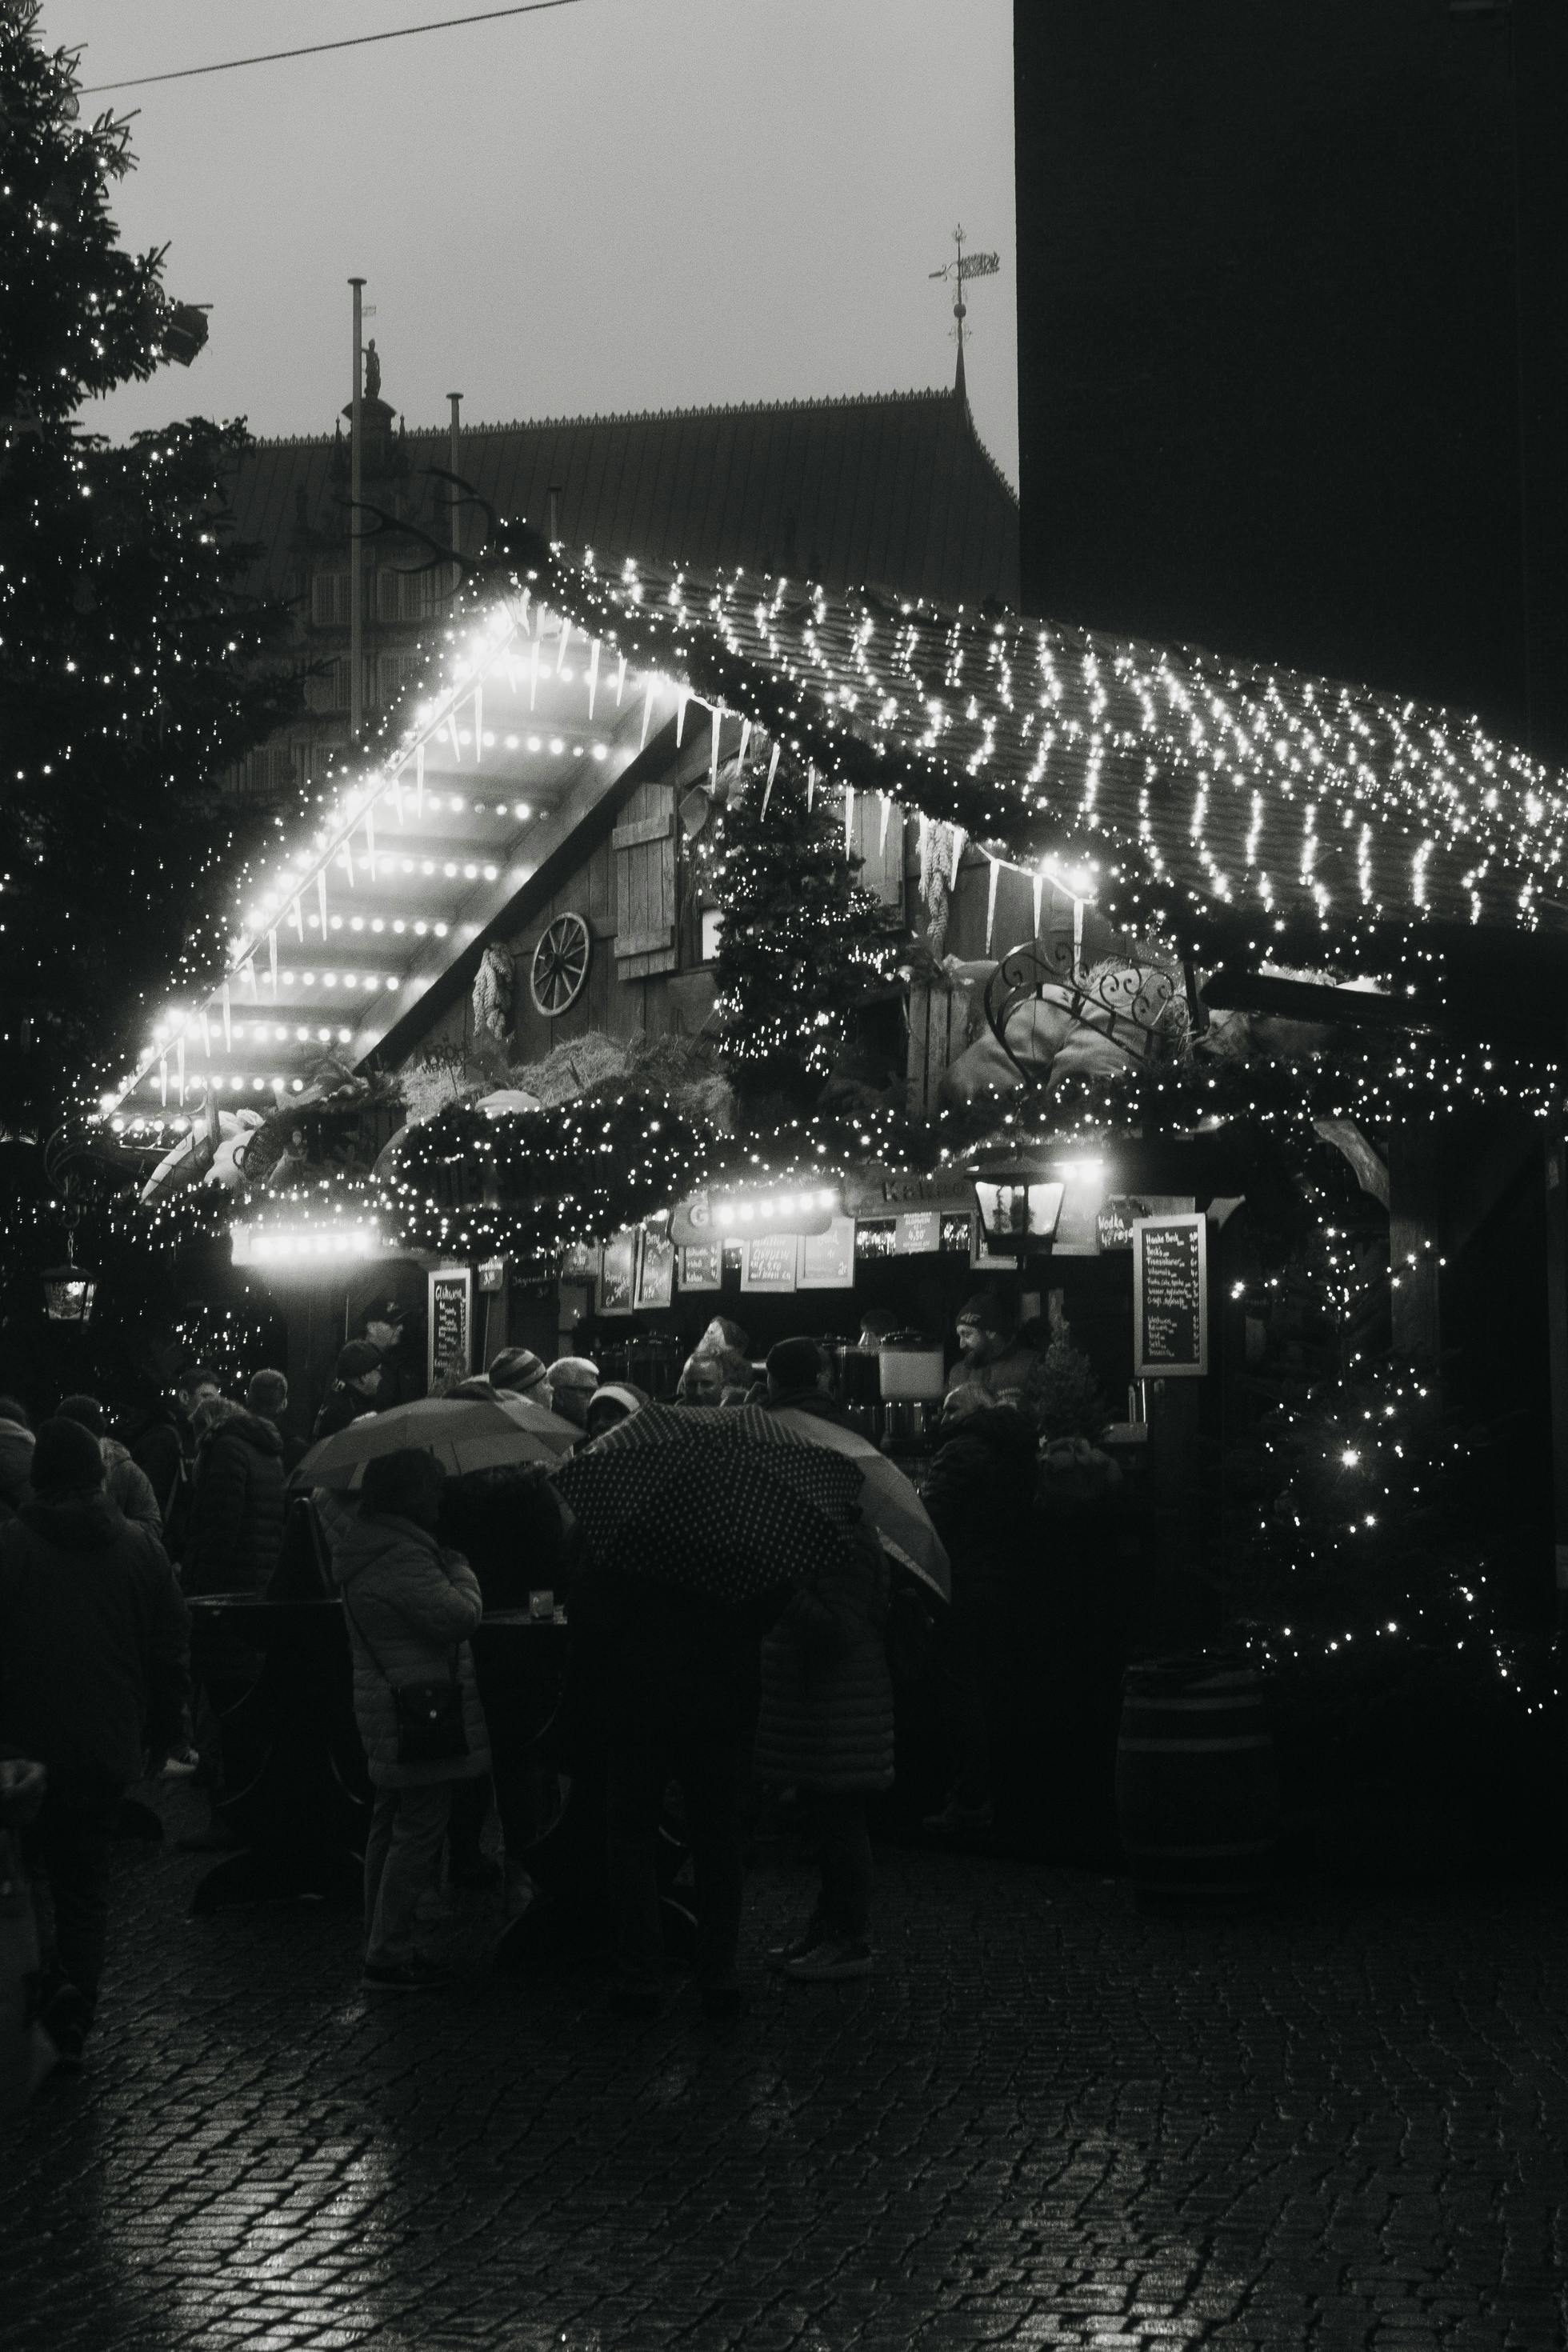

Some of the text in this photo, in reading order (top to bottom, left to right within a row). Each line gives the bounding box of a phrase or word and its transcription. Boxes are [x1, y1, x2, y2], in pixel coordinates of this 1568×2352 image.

[1098, 1213, 1125, 1230] Wodka
[1146, 1233, 1164, 1245] Haake
[1166, 1232, 1178, 1242] Beck
